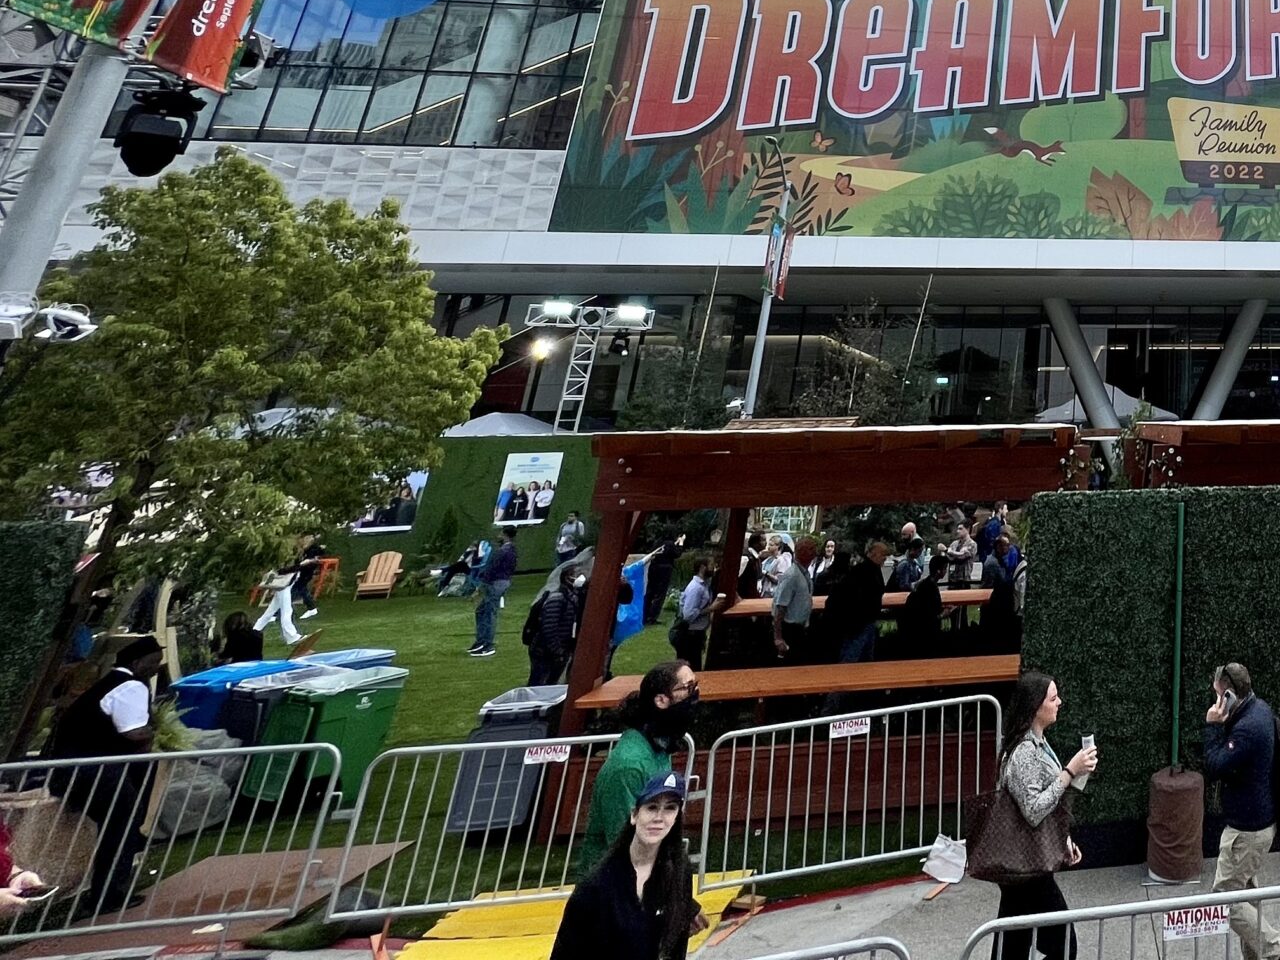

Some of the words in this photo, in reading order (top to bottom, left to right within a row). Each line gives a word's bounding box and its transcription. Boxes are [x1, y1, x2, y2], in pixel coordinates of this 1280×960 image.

[1188, 106, 1268, 140] Family
[1197, 132, 1277, 156] Reunion
[1209, 164, 1265, 179] 2022
[831, 718, 869, 730] NATIONAL
[527, 744, 569, 756] NATIONAL
[1166, 905, 1228, 927] NATIONAL
